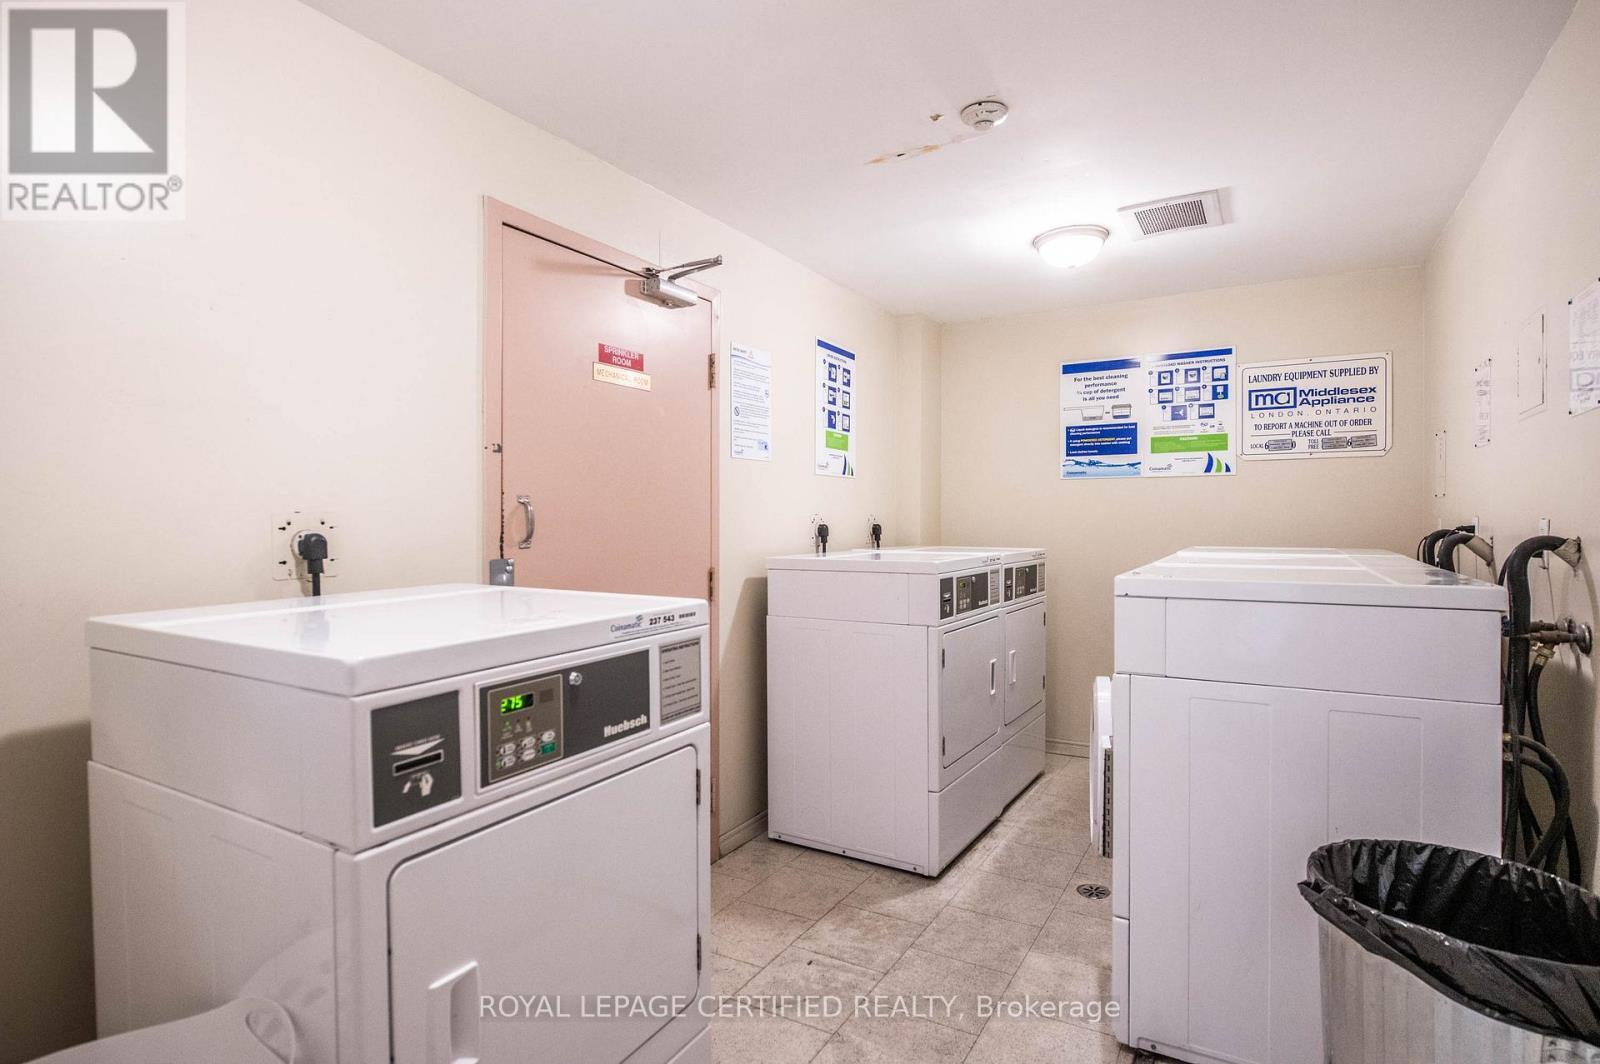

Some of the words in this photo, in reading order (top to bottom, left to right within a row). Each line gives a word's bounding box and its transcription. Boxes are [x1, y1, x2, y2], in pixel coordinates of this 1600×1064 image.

[604, 344, 639, 360] SPRINKLER
[612, 356, 632, 367] ROOM
[596, 368, 631, 382] MECHANICAL
[633, 375, 649, 386] ROOM
[1248, 372, 1282, 384] LAUNDRY
[1284, 370, 1327, 381] EQUIPMENT
[1329, 366, 1367, 378] SUPPLIED
[1369, 366, 1379, 375] BY
[1299, 386, 1377, 398] Middlesex
[1298, 395, 1375, 407] Appliance
[1315, 406, 1377, 416] ONTARIO
[1254, 423, 1262, 431] TO
[1263, 422, 1287, 431] REPORT
[1288, 421, 1293, 429] A
[1294, 420, 1323, 429] MACHINE
[1324, 419, 1337, 427] OUT
[1339, 419, 1348, 427] OF
[1350, 418, 1372, 427] ORDER
[1291, 429, 1314, 438] PLEASE
[1315, 429, 1332, 437] CALL
[610, 621, 641, 632] Coinamatic
[649, 616, 661, 626] 237
[663, 614, 675, 623] 543
[604, 713, 647, 737] Huebsch
